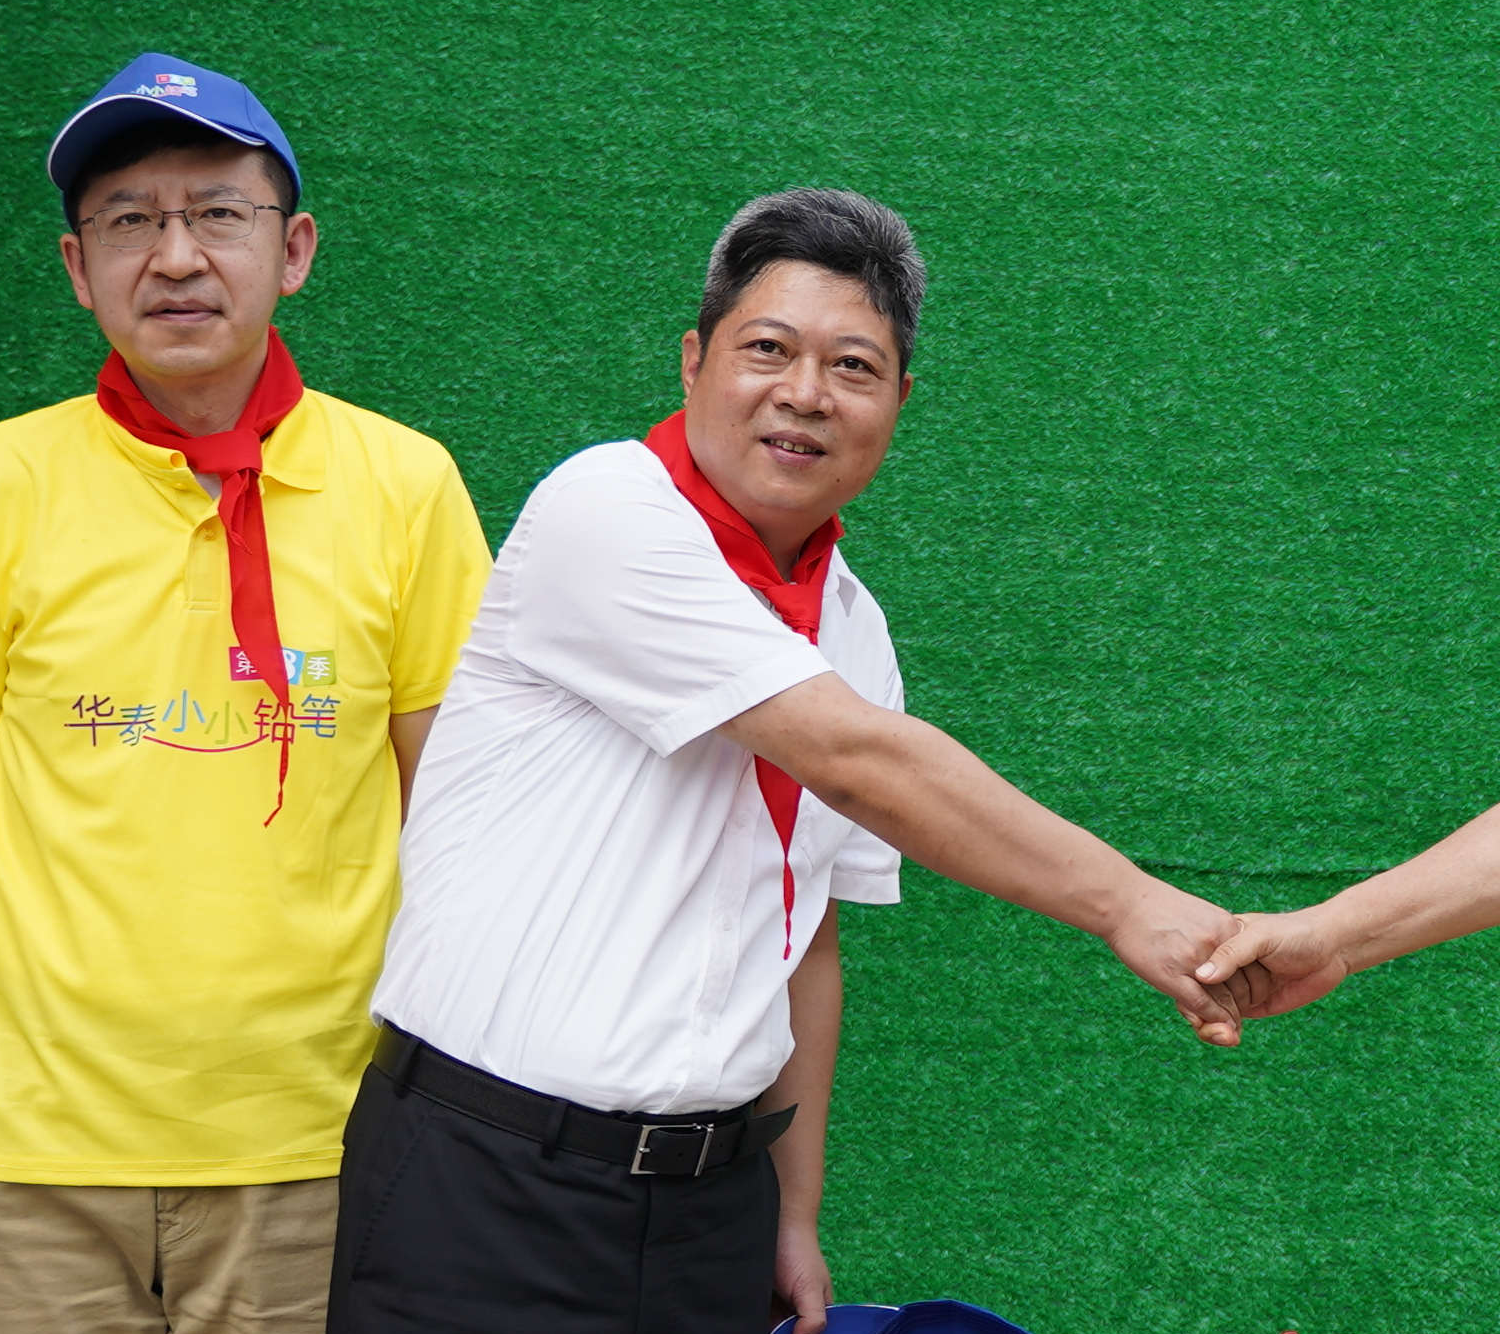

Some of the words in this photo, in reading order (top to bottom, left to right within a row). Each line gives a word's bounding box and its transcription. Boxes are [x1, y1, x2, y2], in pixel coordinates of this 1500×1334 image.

[64, 689, 341, 748] 华泰小小铅笔
